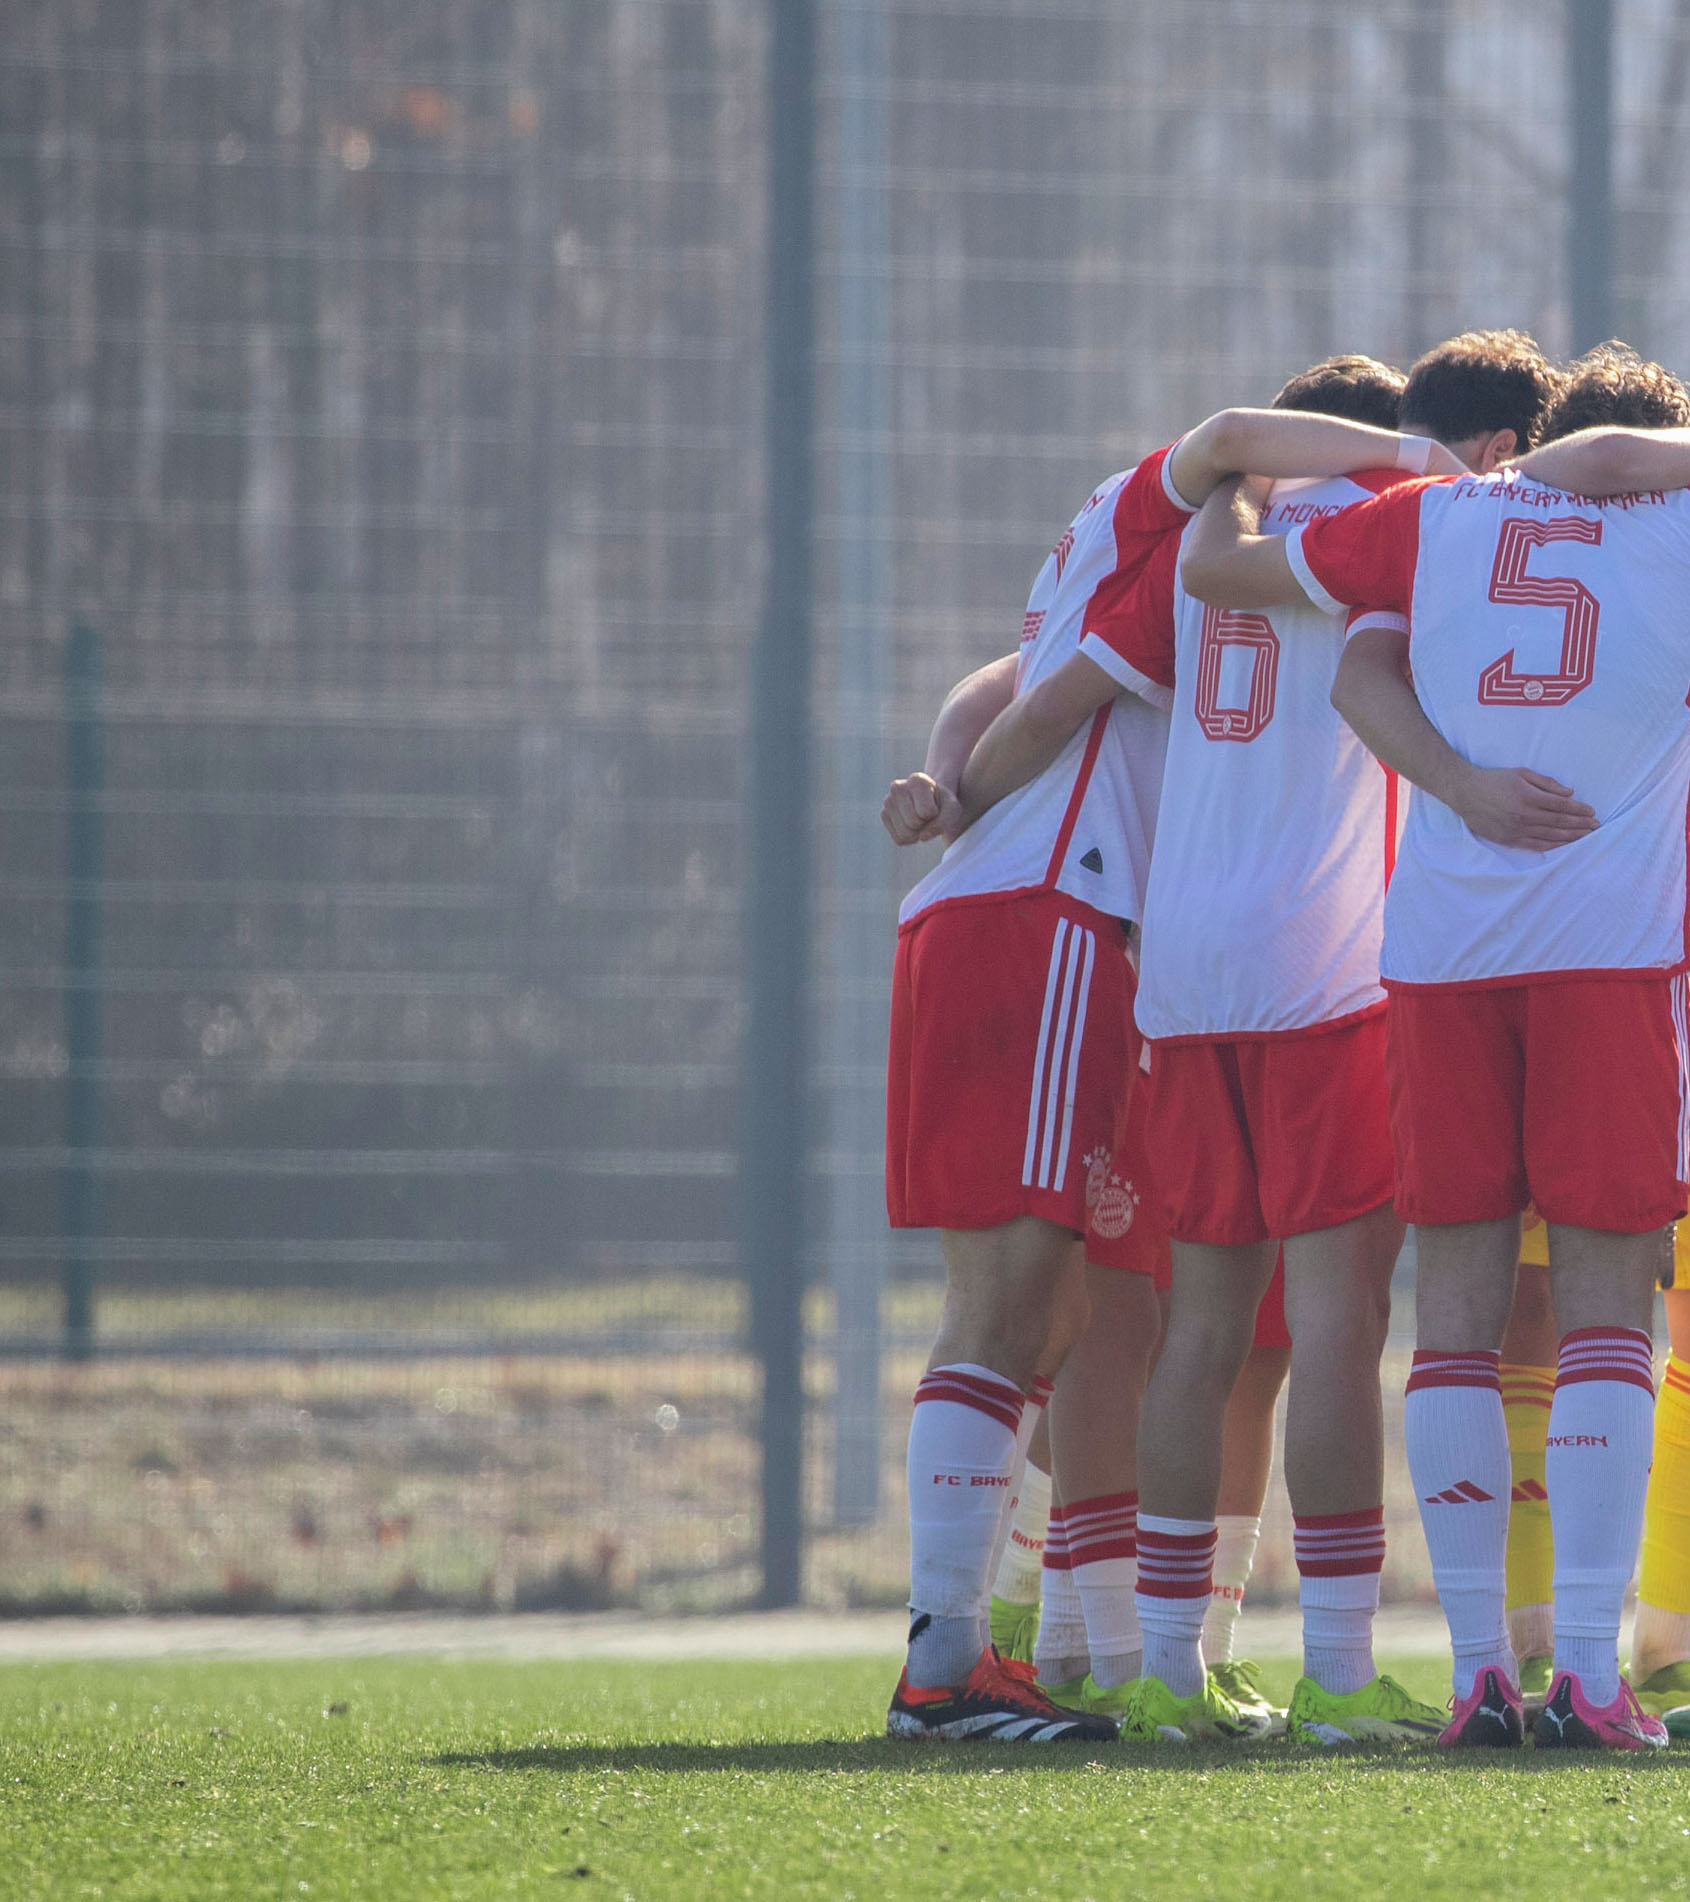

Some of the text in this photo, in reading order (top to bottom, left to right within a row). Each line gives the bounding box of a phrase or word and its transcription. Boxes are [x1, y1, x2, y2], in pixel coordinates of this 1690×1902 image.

[1454, 482, 1480, 501] FC
[1478, 515, 1603, 706] 5
[1194, 602, 1281, 743] 6
[933, 1474, 962, 1486] FC
